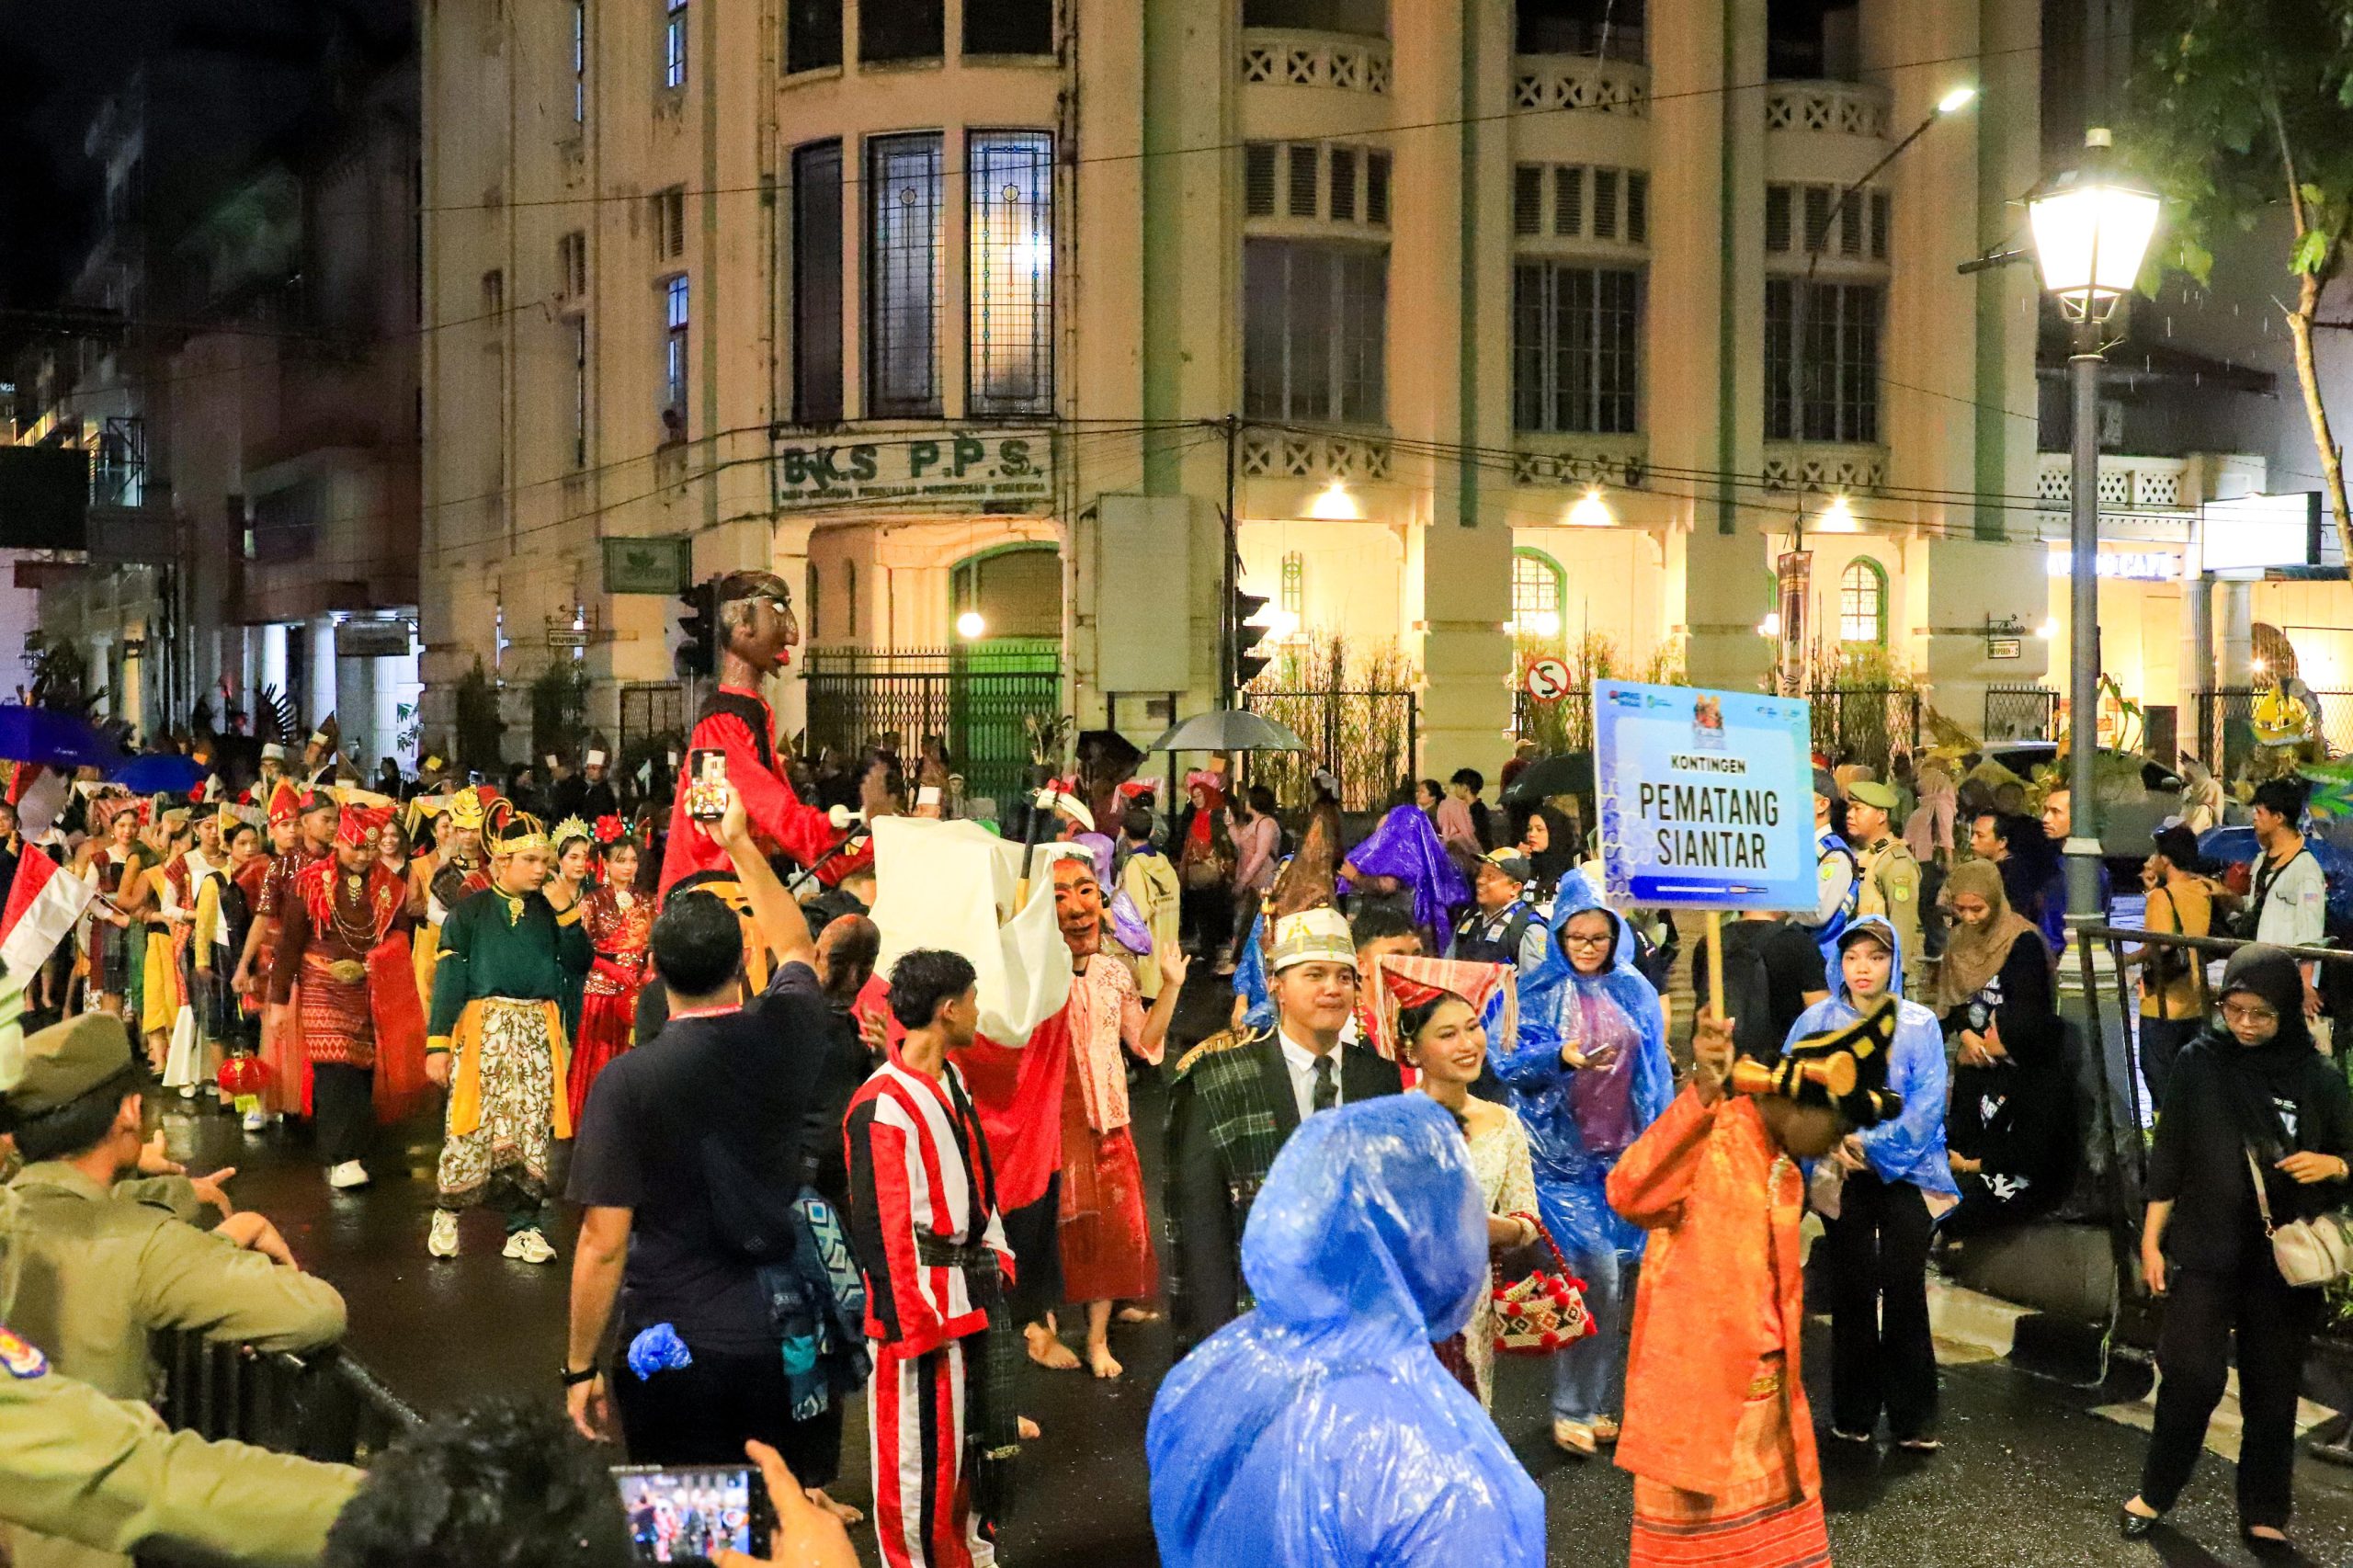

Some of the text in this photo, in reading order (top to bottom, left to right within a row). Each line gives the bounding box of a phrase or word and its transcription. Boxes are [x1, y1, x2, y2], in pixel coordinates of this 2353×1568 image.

[1671, 755, 1745, 774] KONTINGEN
[1640, 782, 1779, 826] PEMATANG
[1657, 828, 1767, 869] SIANTAR
